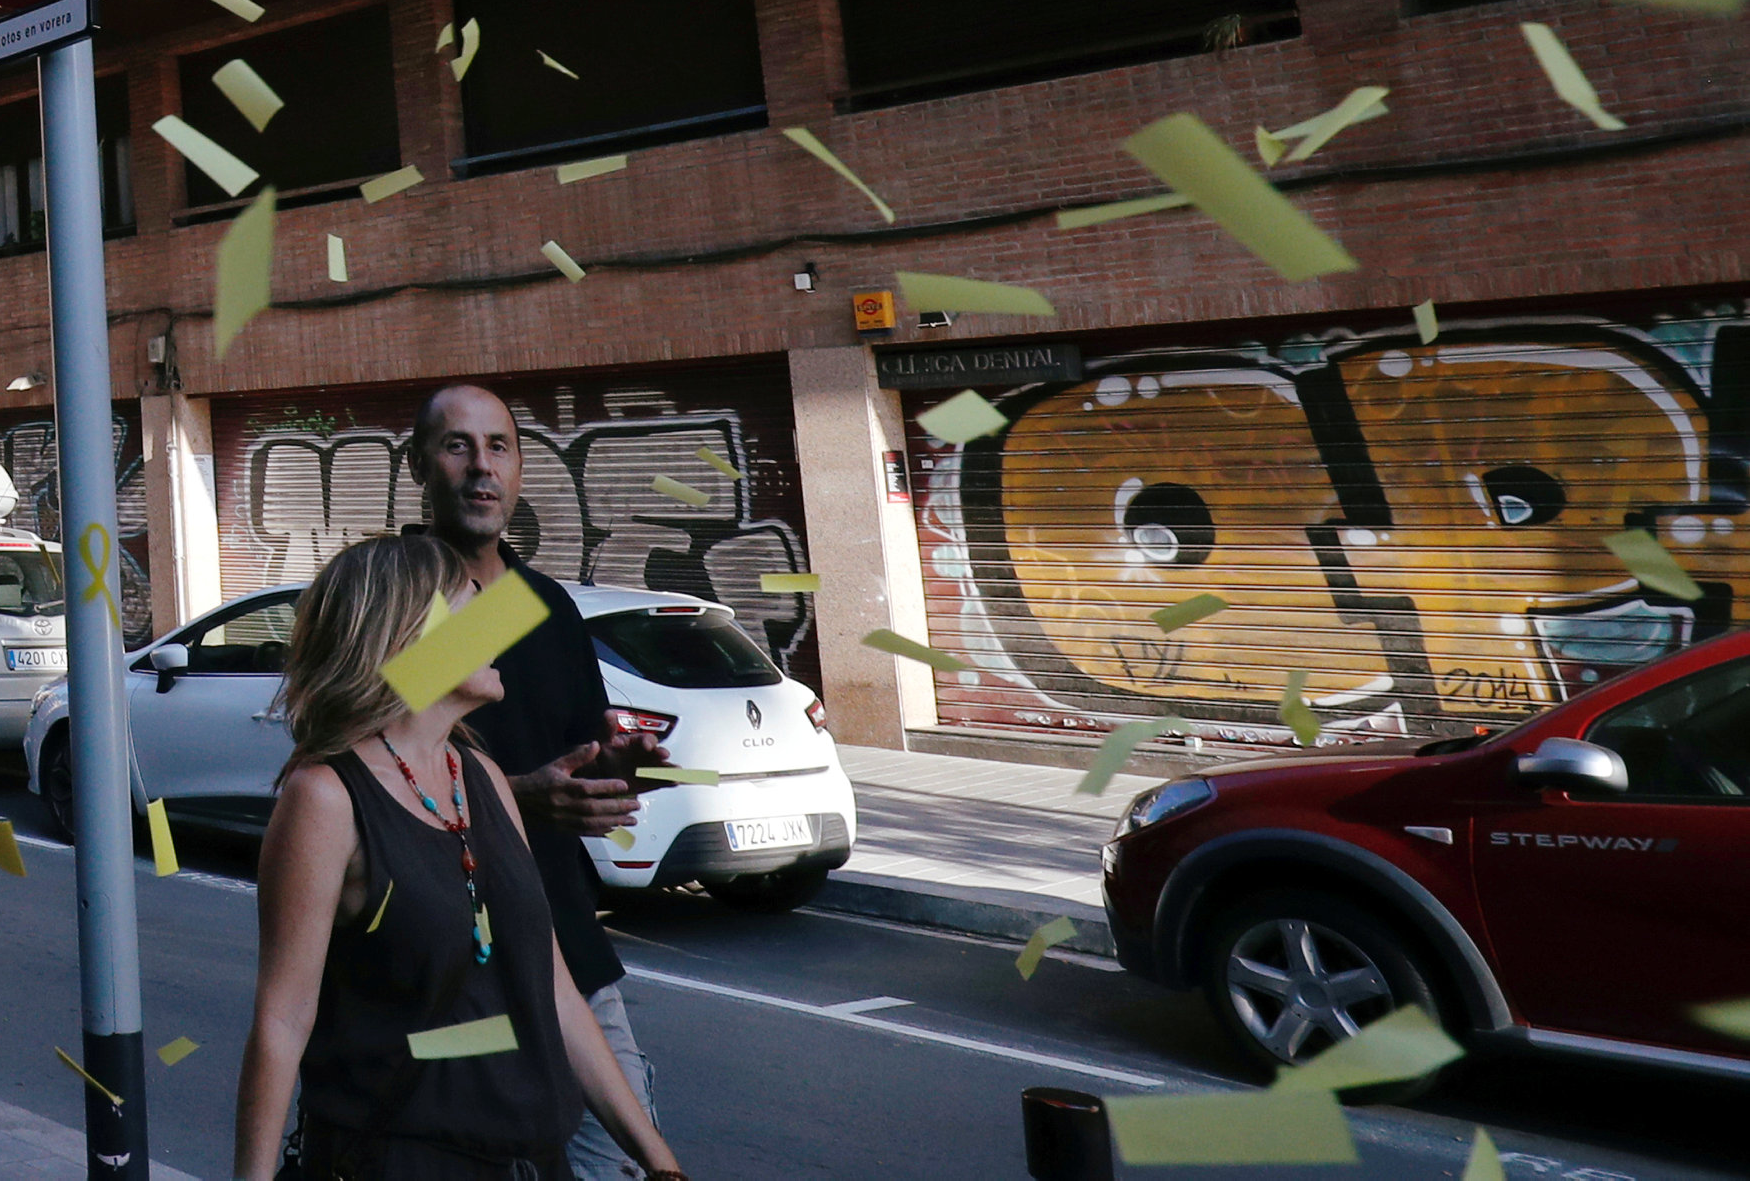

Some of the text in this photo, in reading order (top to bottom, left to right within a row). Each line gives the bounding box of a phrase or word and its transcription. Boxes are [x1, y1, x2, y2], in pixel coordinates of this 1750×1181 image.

[24, 25, 37, 38] en
[39, 12, 72, 33] vorera
[973, 347, 1061, 370] DENTAL
[17, 651, 66, 666] 4201 CX
[1439, 667, 1538, 710] 2014
[742, 737, 775, 748] CLIO
[736, 818, 808, 846] 7224 JXK
[1489, 831, 1654, 852] STEPWAY
